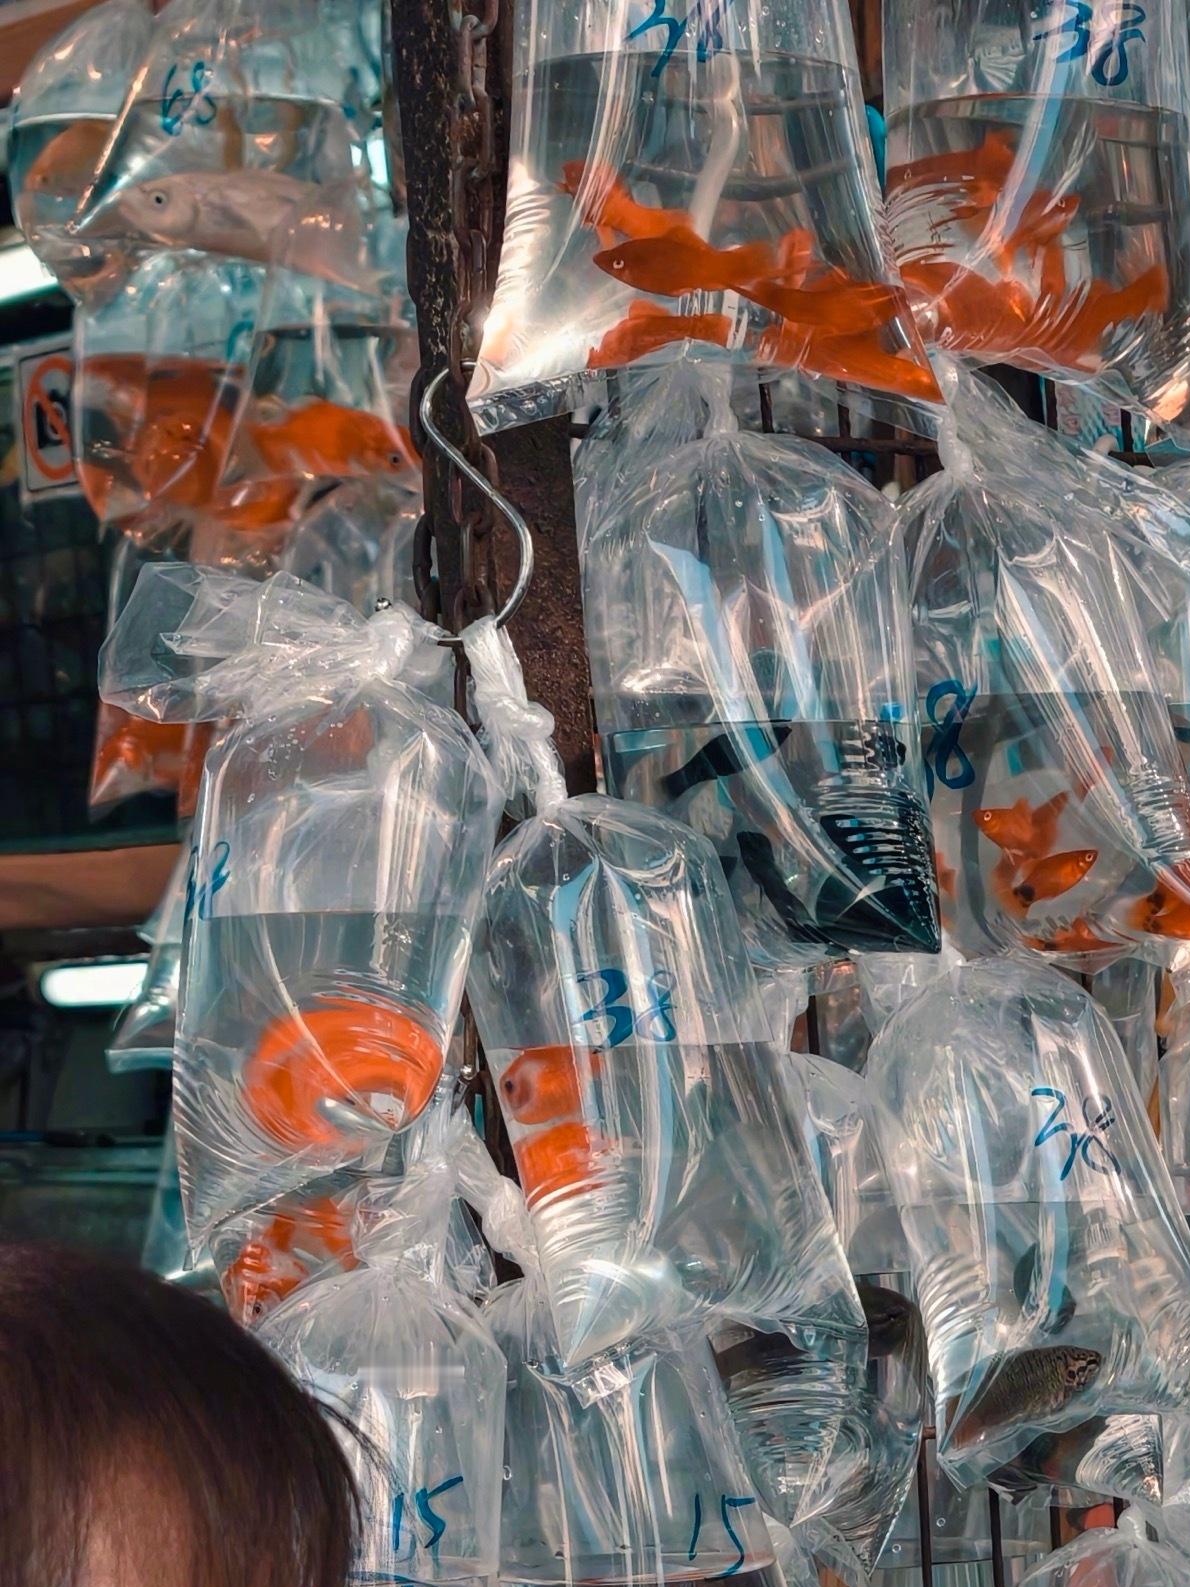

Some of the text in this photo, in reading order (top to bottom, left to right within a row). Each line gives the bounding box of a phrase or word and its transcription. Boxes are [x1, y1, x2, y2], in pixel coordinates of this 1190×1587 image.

[570, 968, 677, 1049] 38
[390, 1475, 464, 1551] 15
[687, 1494, 757, 1581] 15
